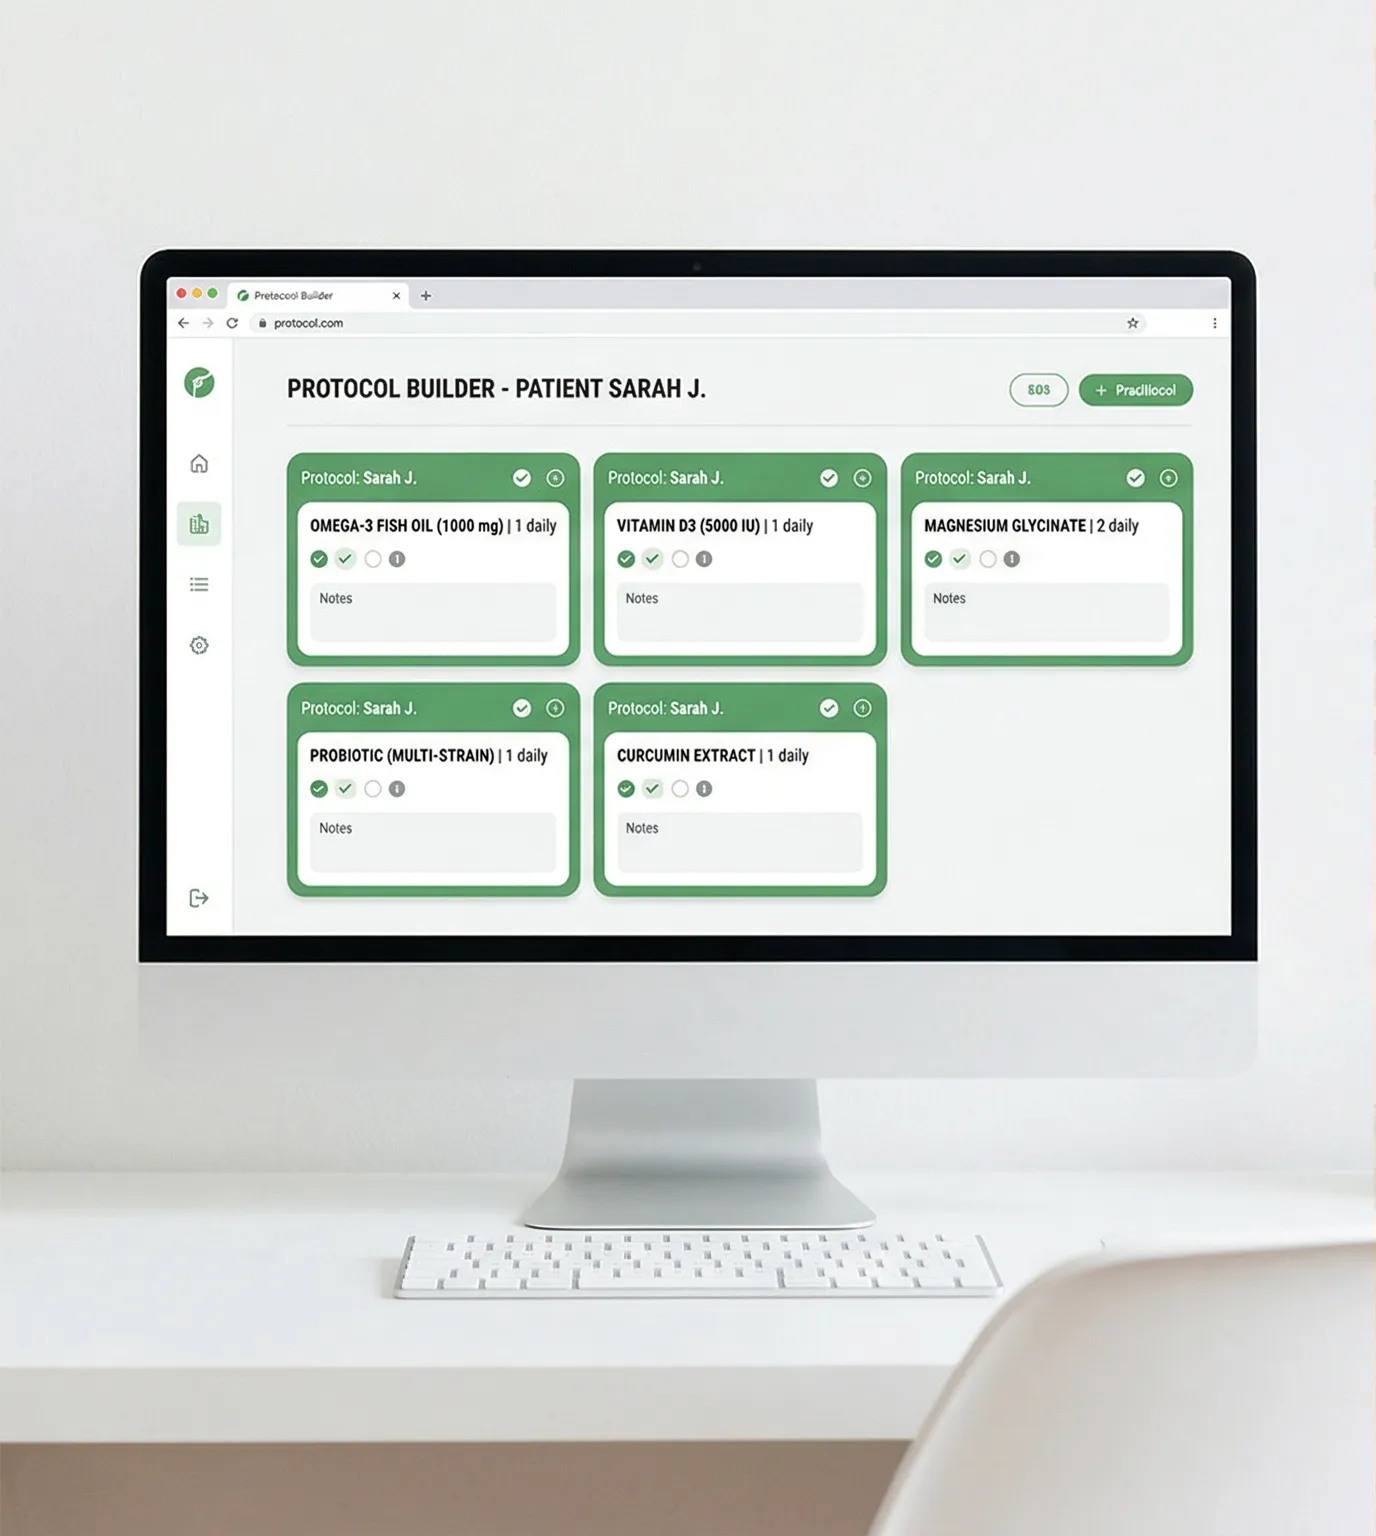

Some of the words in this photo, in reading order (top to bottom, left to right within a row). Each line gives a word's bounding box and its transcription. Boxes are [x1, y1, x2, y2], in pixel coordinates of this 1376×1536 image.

[274, 317, 343, 330] protocol.com
[288, 377, 400, 399] PROTOCOL
[408, 377, 495, 399] BUILDER
[517, 377, 603, 399] PATIENT
[609, 377, 680, 399] SARAH
[688, 377, 705, 399] J.
[302, 470, 360, 485] Protocol:
[363, 470, 401, 485] Sarah
[405, 470, 417, 485] J.
[609, 470, 667, 485] Protocol:
[670, 470, 708, 485] Sarah
[712, 470, 724, 485] J.
[916, 470, 974, 485] Protocol:
[977, 470, 1015, 485] Sarah
[1019, 470, 1031, 485] J.
[311, 518, 373, 533] OMEGA-3
[377, 518, 408, 533] FISH
[412, 518, 434, 533] OIL
[437, 517, 475, 536] (1000
[479, 517, 503, 537] mg)
[526, 517, 556, 537] daily
[617, 518, 675, 533] VITAMIN
[679, 518, 697, 533] D3
[700, 517, 738, 536] (5000
[742, 517, 760, 536] IU)
[783, 517, 813, 537] daily
[924, 518, 1008, 533] MAGNESIUM
[1012, 518, 1086, 533] GLYCINATE
[1097, 518, 1106, 533] 2
[1109, 517, 1139, 537] daily
[320, 592, 352, 605] Notes
[626, 592, 658, 605] Notes
[934, 592, 966, 605] Notes
[302, 701, 360, 716] Protocol:
[363, 701, 401, 716] Sarah
[405, 701, 417, 716] J.
[609, 701, 667, 716] Protocol:
[670, 701, 708, 716] Sarah
[712, 701, 724, 716] J.
[311, 748, 383, 763] PROBIOTIC
[387, 747, 494, 766] (MULTI-STRAIN)
[517, 747, 547, 767] daily
[617, 748, 689, 763] CURCUMIN
[693, 748, 756, 763] EXTRACT
[778, 747, 809, 767] daily
[320, 822, 352, 835] Notes
[627, 822, 659, 835] Notes
